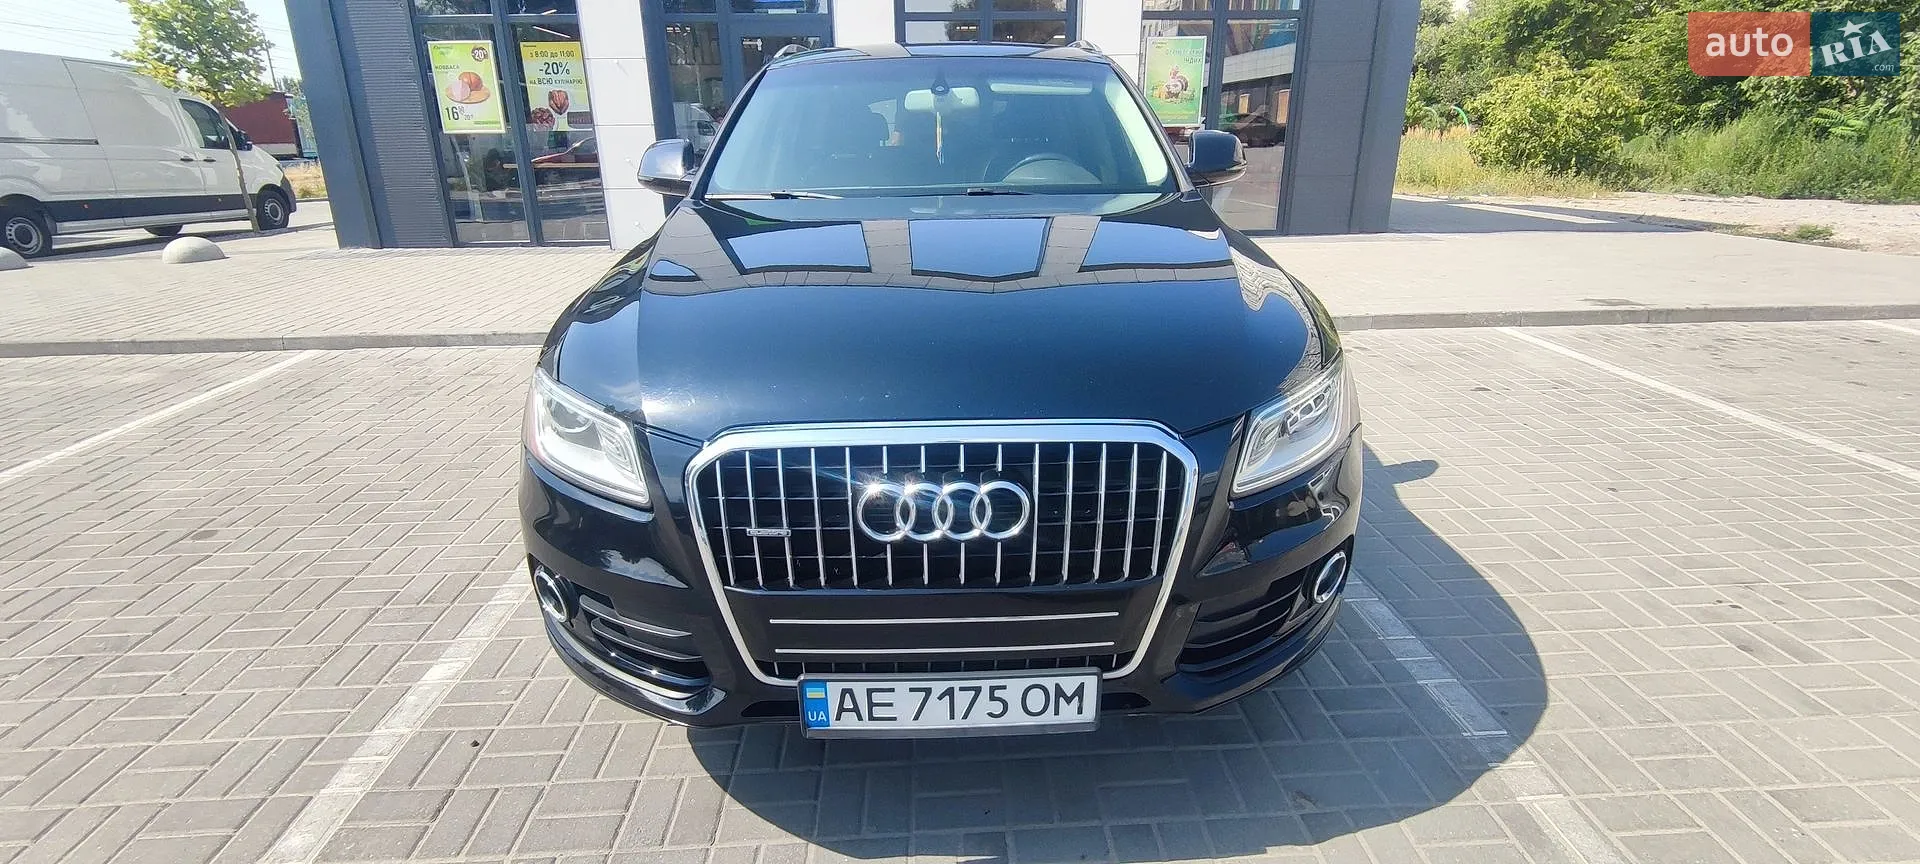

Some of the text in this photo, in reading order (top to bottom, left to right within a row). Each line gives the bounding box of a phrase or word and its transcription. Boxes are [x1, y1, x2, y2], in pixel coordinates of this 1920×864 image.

[539, 62, 571, 75] -20%
[445, 106, 459, 120] 16
[808, 681, 1086, 723] UA AE 7175 OM
